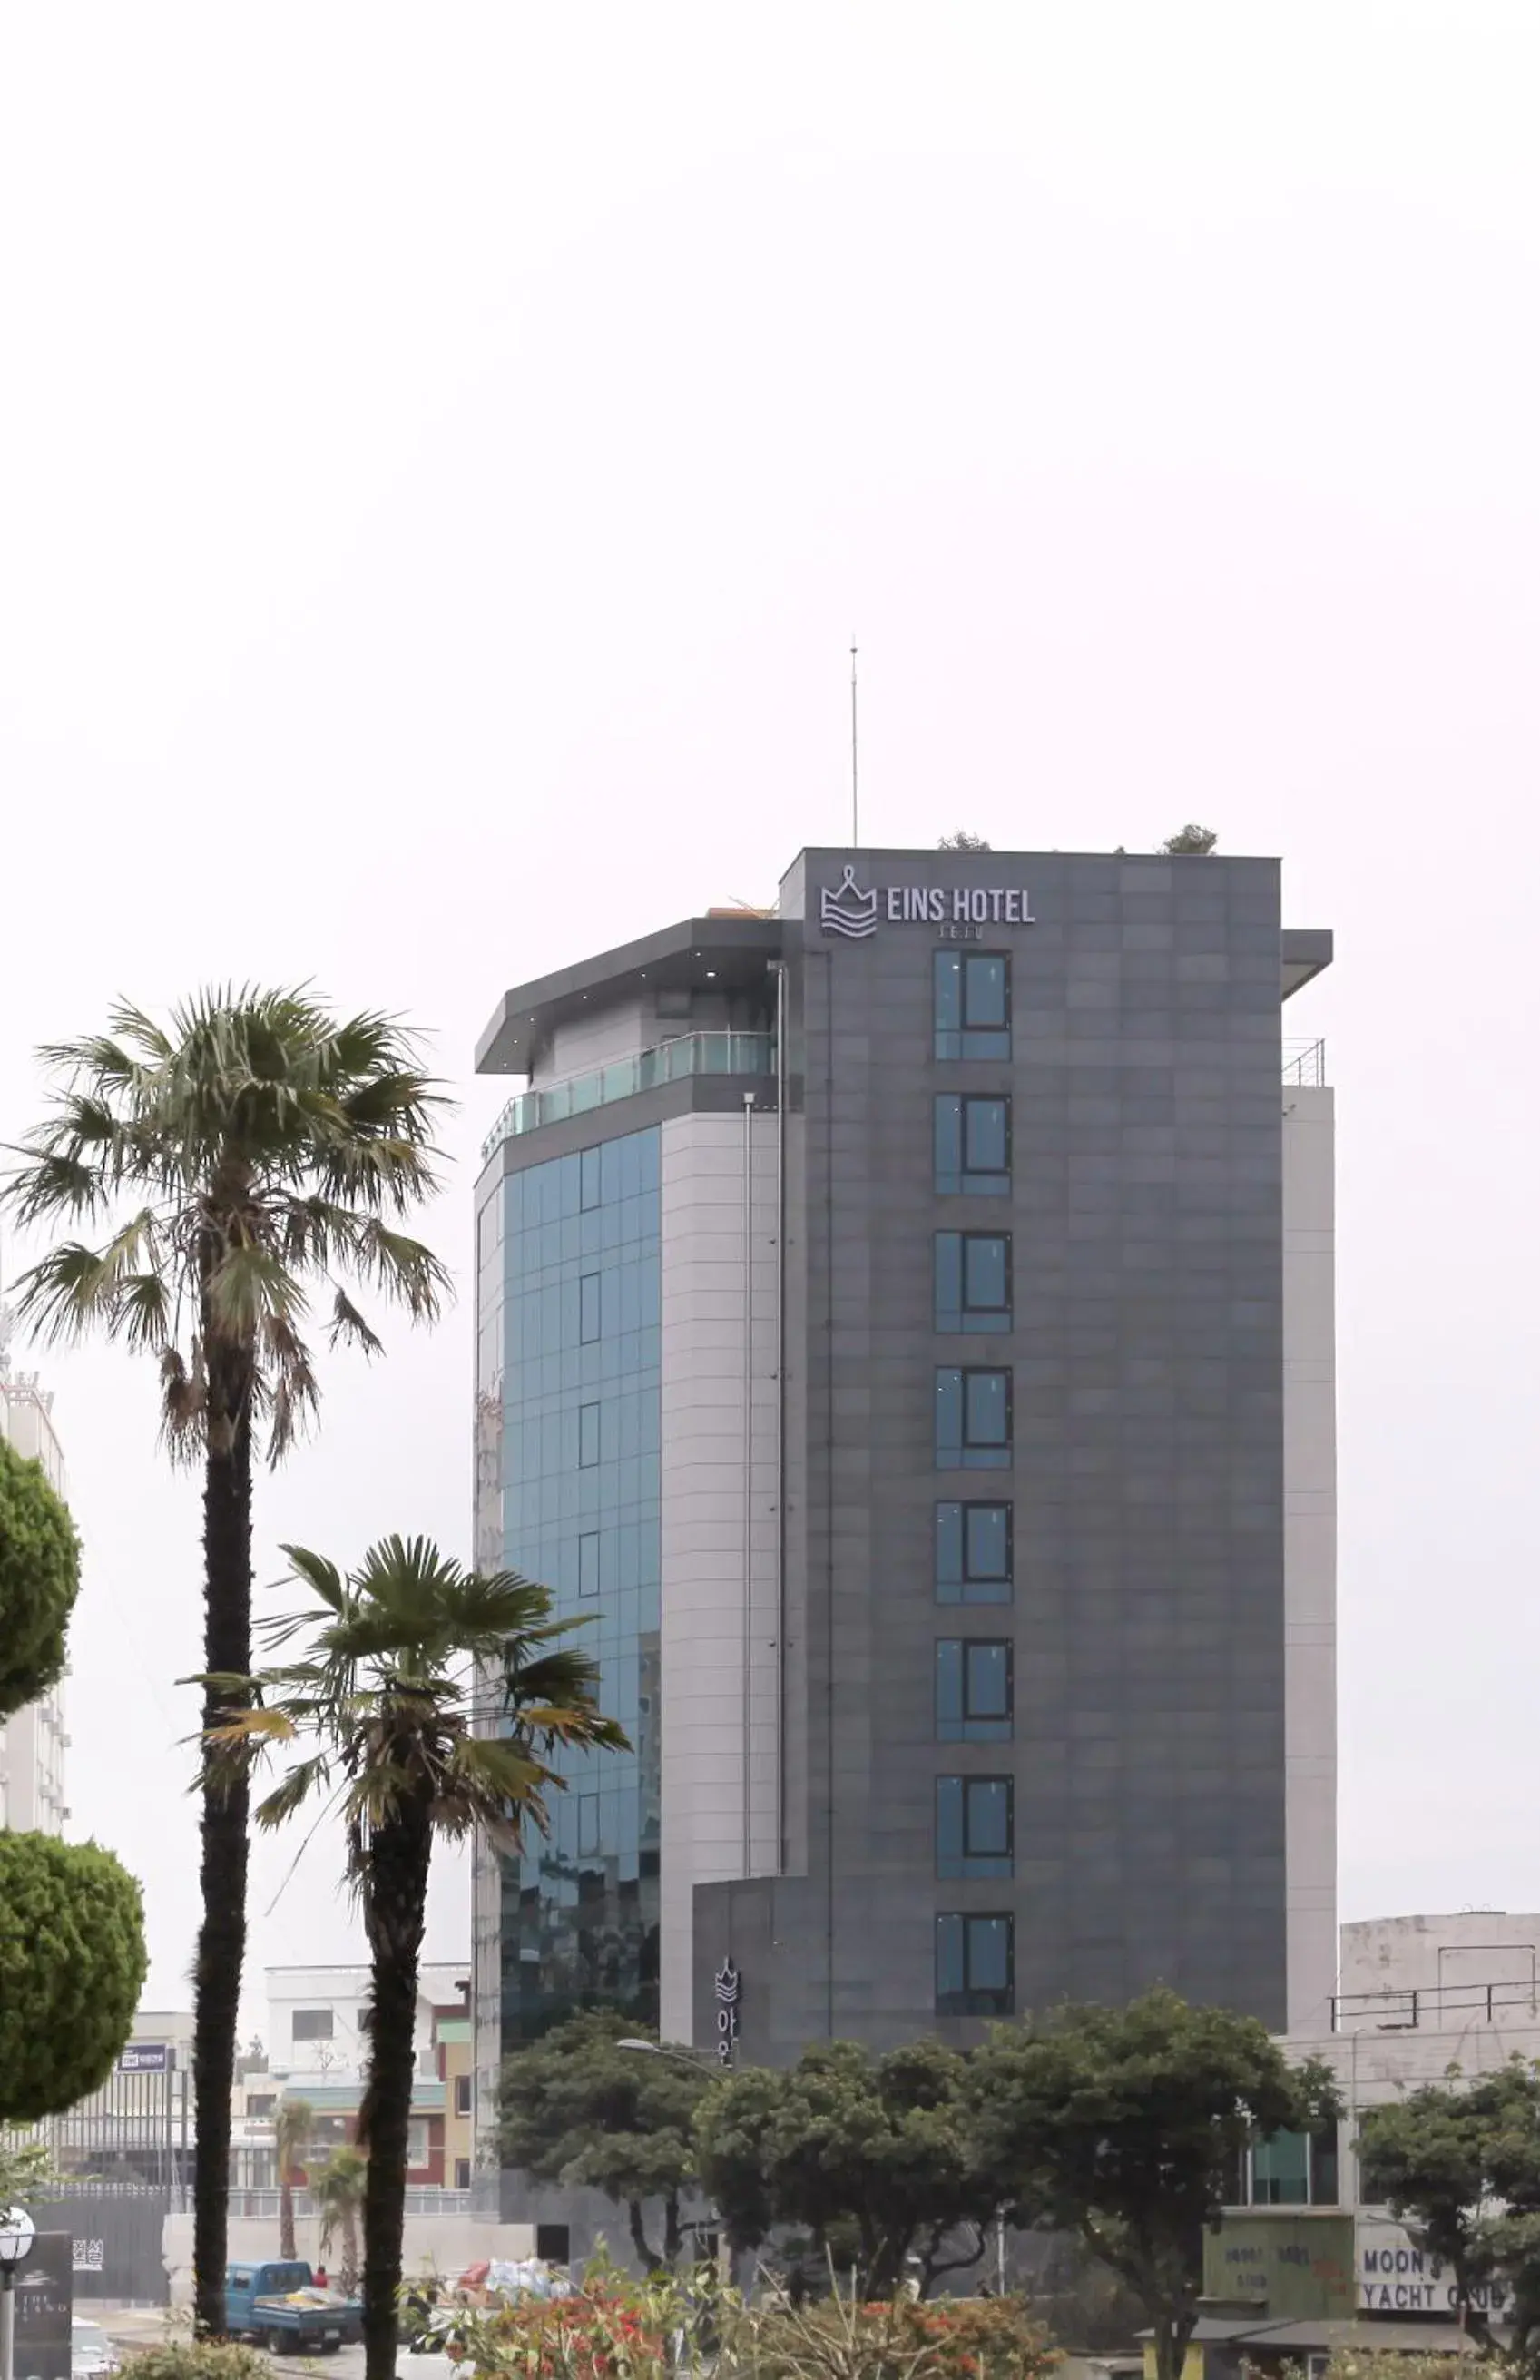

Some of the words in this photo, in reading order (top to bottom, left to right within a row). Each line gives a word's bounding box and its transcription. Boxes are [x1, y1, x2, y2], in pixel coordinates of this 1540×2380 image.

[888, 887, 945, 921] EINS
[954, 888, 1036, 922] HOTEL
[1364, 2248, 1424, 2274] MOON
[1363, 2283, 1436, 2309] YACHT
